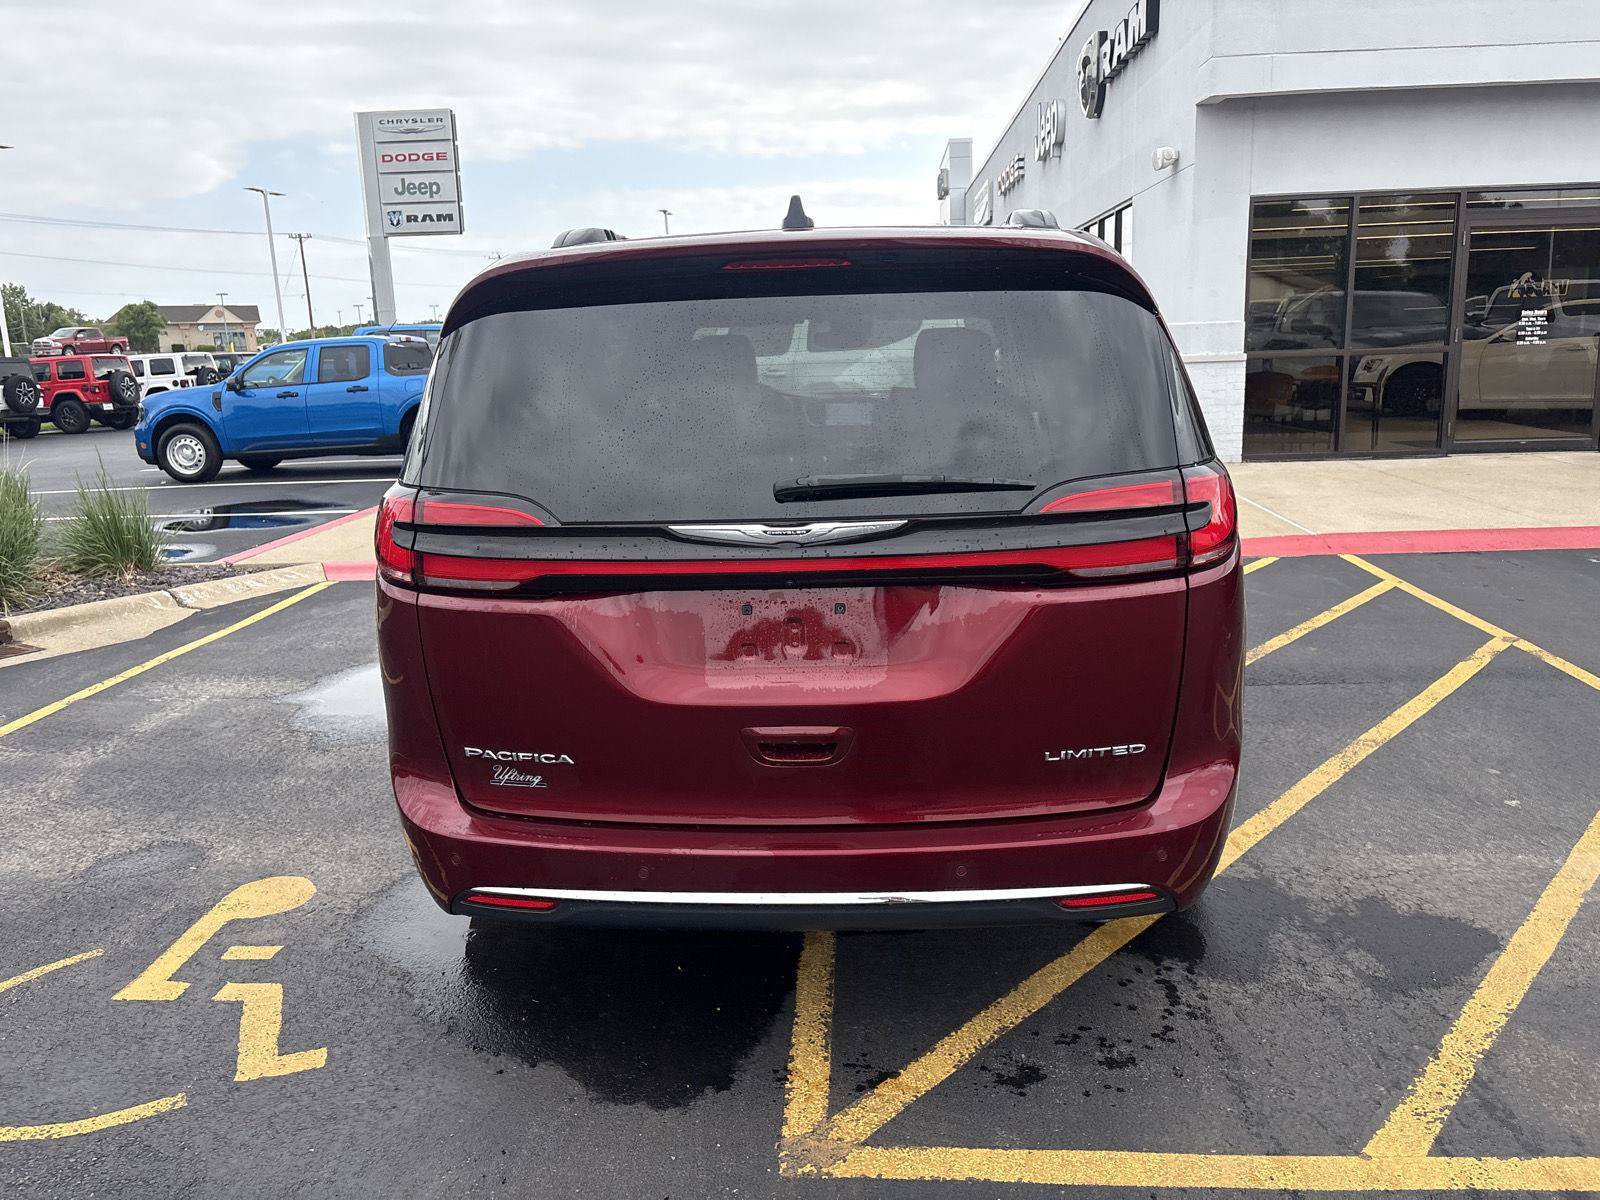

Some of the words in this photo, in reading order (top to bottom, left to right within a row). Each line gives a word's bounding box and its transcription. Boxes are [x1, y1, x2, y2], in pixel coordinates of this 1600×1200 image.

[1098, 0, 1153, 84] RAM
[378, 117, 444, 125] CHRYSLER
[1034, 100, 1062, 161] Jeep
[381, 152, 448, 163] DODGE
[393, 178, 441, 198] Jeep
[405, 213, 454, 223] RAM
[463, 746, 575, 765] PACIFICA
[1044, 743, 1147, 761] LIMITED
